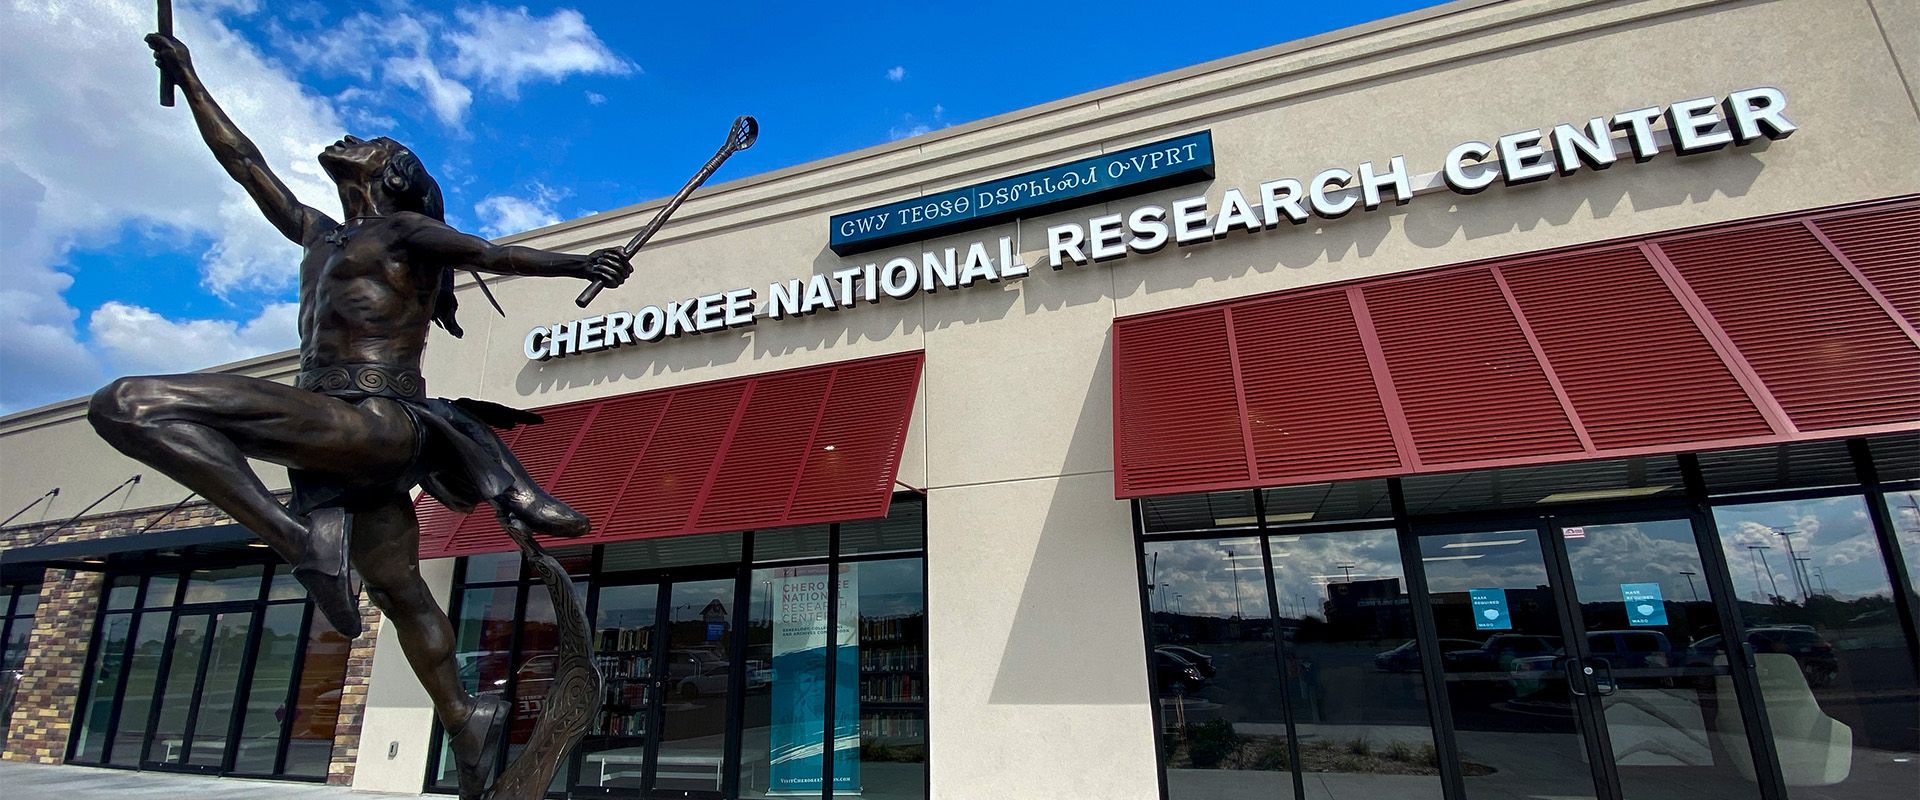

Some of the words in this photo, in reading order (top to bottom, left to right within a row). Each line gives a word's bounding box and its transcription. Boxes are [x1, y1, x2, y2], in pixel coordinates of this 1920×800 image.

[523, 288, 757, 361] CHEROKEE
[768, 235, 1029, 319] NATIONAL
[1047, 154, 1413, 269] RESEARCH
[1444, 86, 1797, 194] CENTER
[783, 580, 849, 592] CHEROEE
[783, 591, 844, 602] NATIONL
